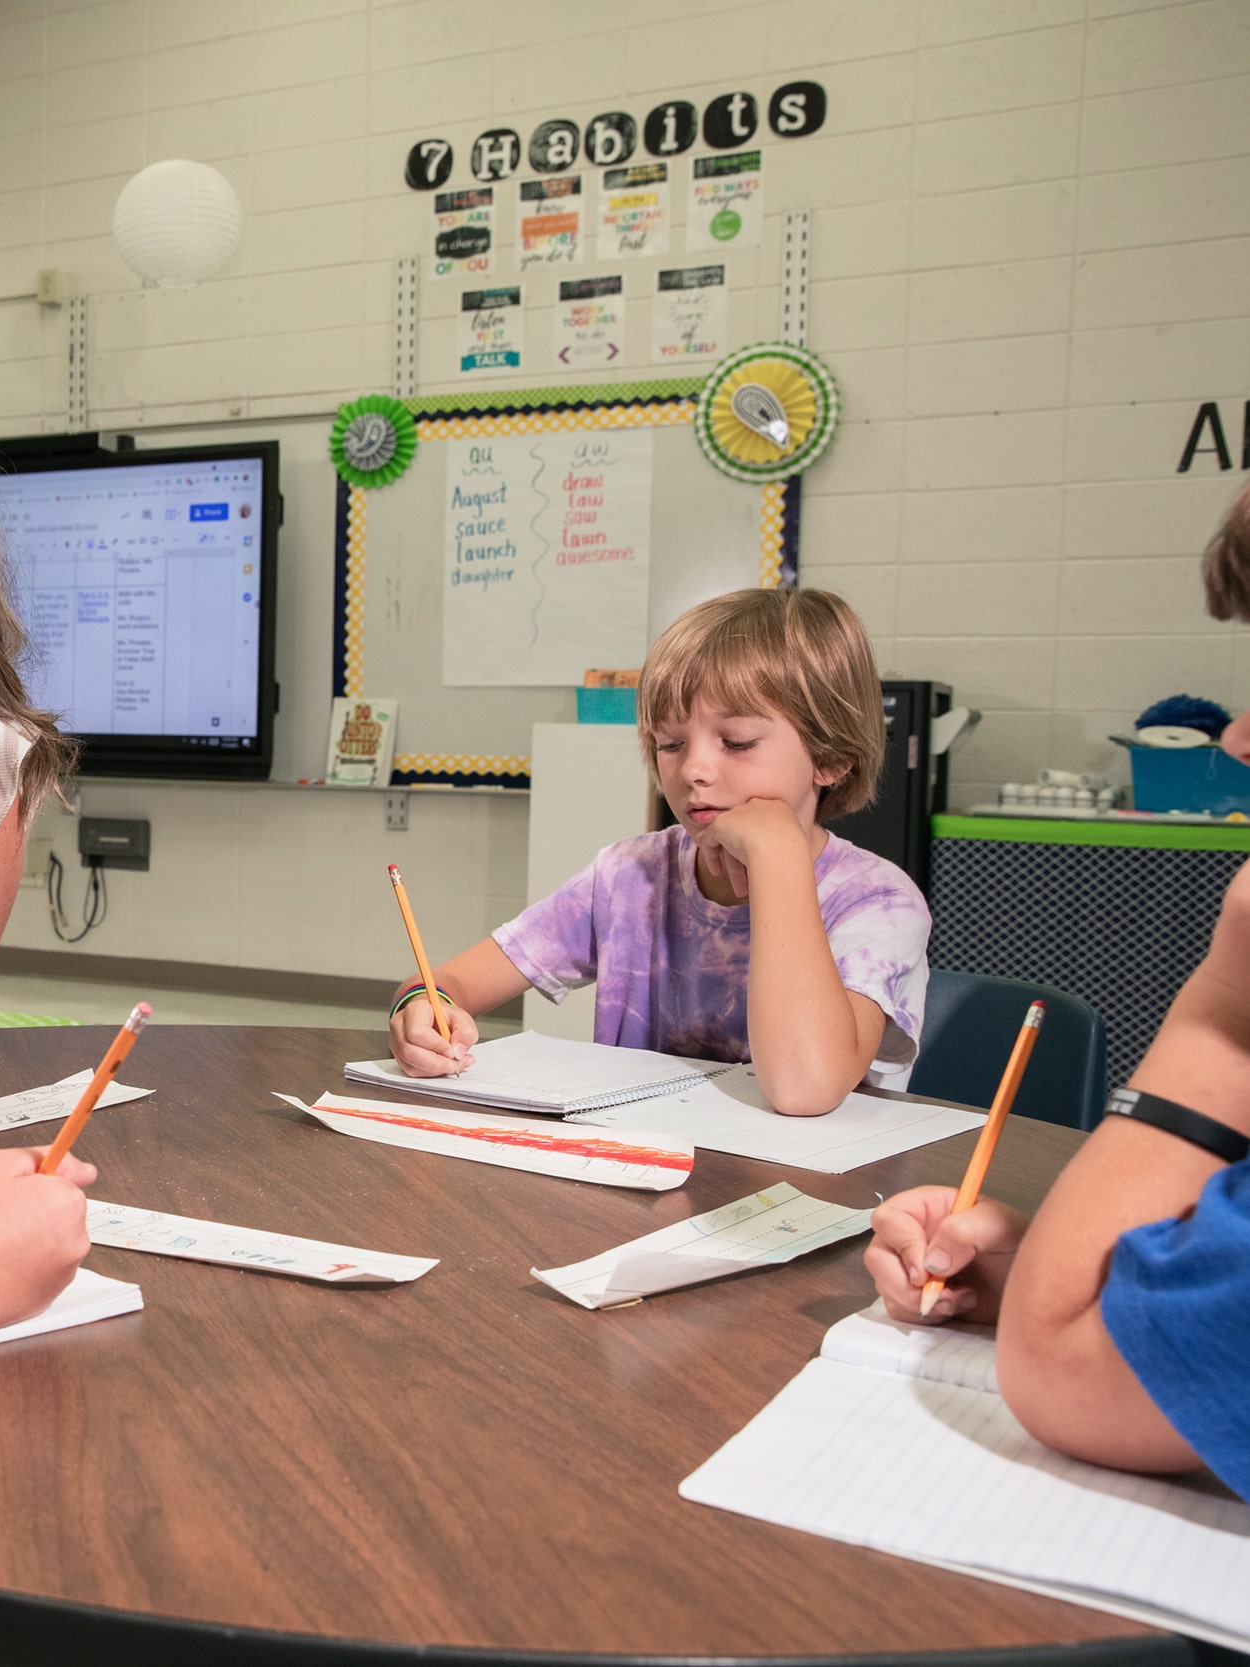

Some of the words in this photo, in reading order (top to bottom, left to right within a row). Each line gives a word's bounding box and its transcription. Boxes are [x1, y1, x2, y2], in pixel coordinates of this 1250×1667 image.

[417, 139, 451, 184] 7
[476, 92, 810, 182] Habits
[437, 213, 464, 227] YOU
[467, 211, 491, 223] ARE
[435, 261, 453, 276] OF
[457, 257, 489, 273] YOU
[475, 352, 507, 367] TALK
[1177, 399, 1250, 473] A
[469, 446, 494, 465] au
[574, 441, 610, 459] aw
[562, 471, 604, 492] draw
[451, 482, 507, 519] August
[569, 493, 604, 509] law
[564, 510, 598, 527] saw
[455, 517, 506, 541] sauce
[562, 528, 607, 548] lawn
[456, 539, 517, 564] launch
[556, 547, 635, 566] awesome
[451, 568, 515, 592] daughter
